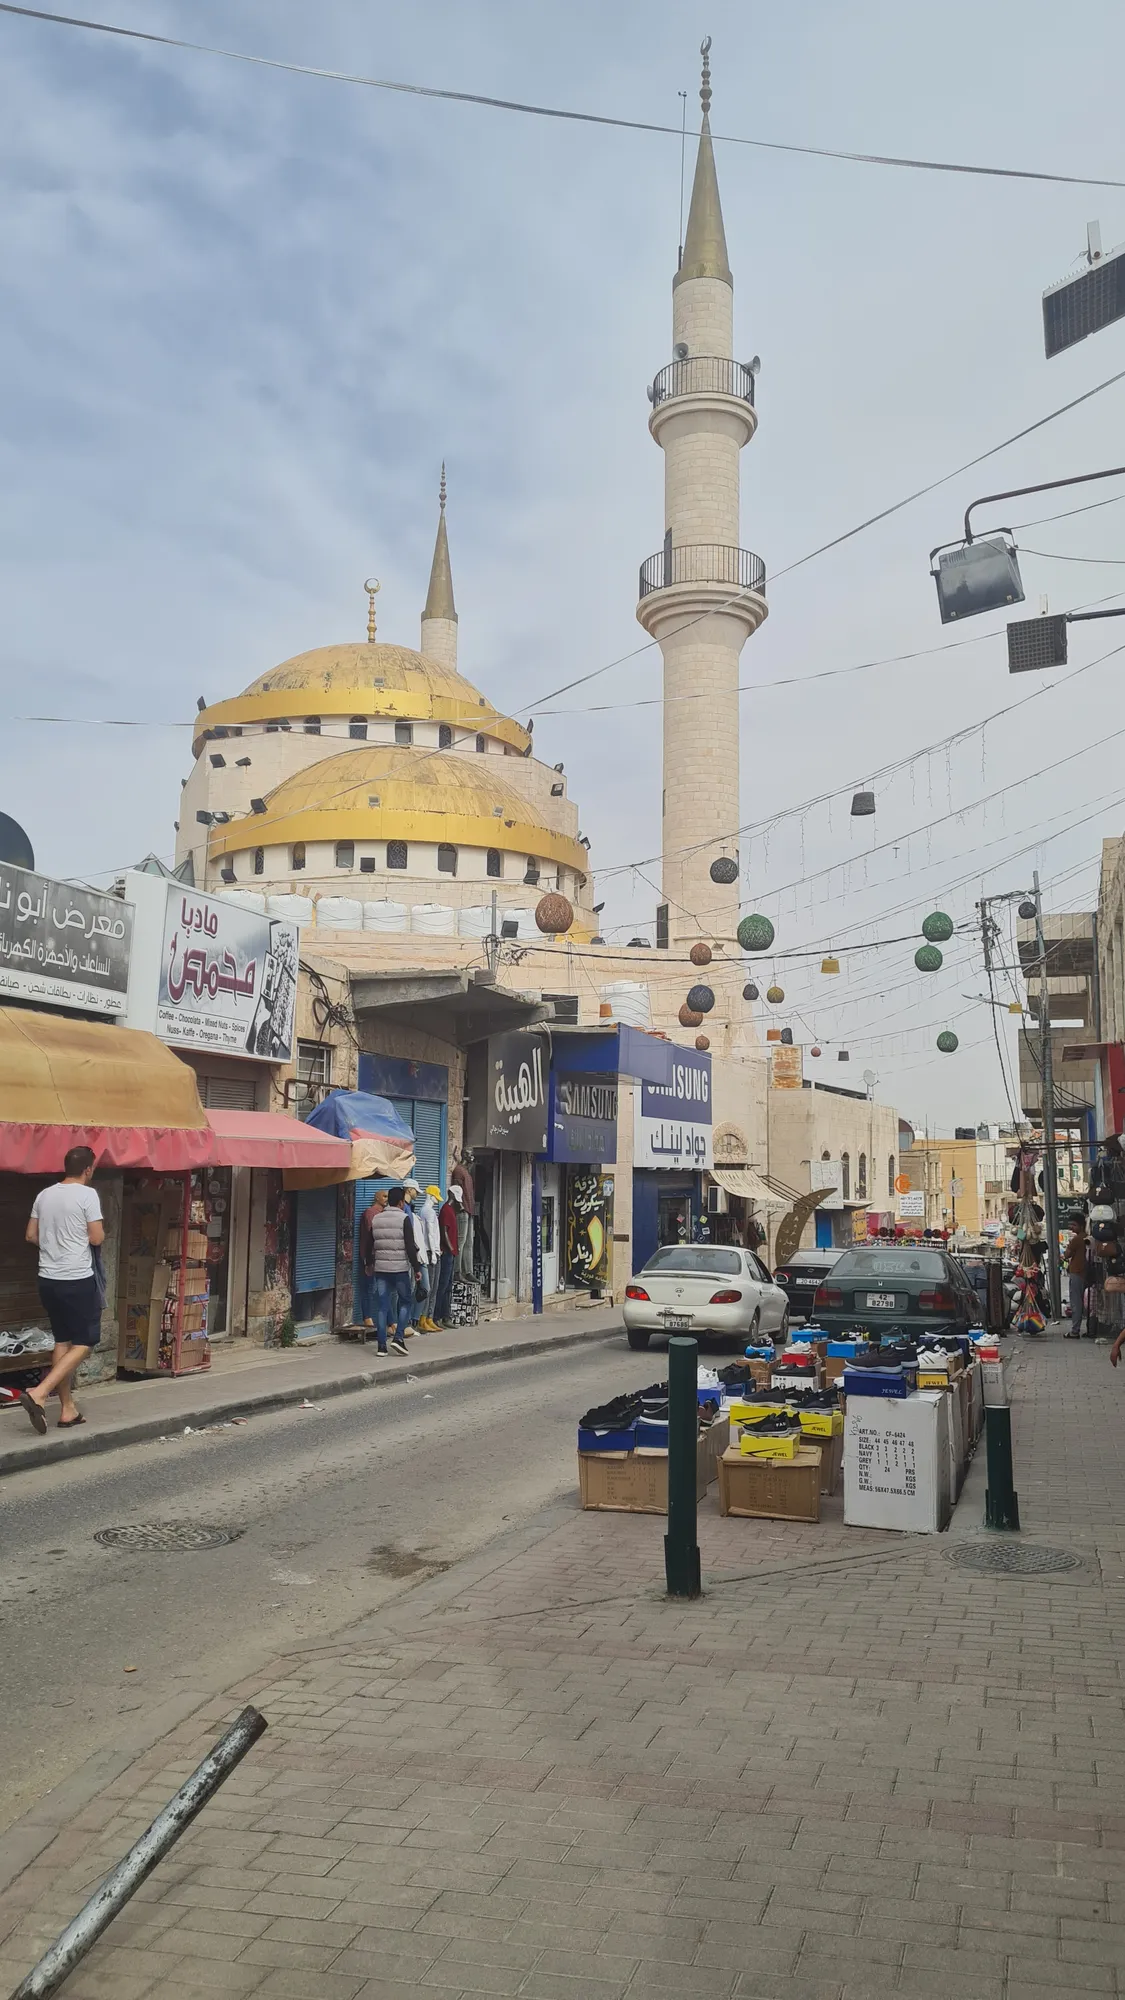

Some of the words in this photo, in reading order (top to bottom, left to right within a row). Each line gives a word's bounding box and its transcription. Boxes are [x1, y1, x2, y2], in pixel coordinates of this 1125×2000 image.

[17, 882, 49, 925] أبو
[53, 901, 125, 939] معرض
[181, 897, 218, 938] مادبا
[38, 943, 79, 974] والأجهزة
[79, 952, 111, 976] للساعات
[168, 932, 257, 1005] محمص
[28, 982, 47, 994] شحن
[46, 984, 72, 999] بطاقات
[77, 990, 99, 1004] نظارات
[104, 998, 122, 1010] عطور
[159, 1010, 174, 1020] Coffee
[219, 1021, 228, 1030] Nuts
[232, 1023, 245, 1033] Spices
[495, 1047, 544, 1125] الهيبة
[651, 1124, 682, 1164] لينك
[685, 1127, 706, 1164] جواد
